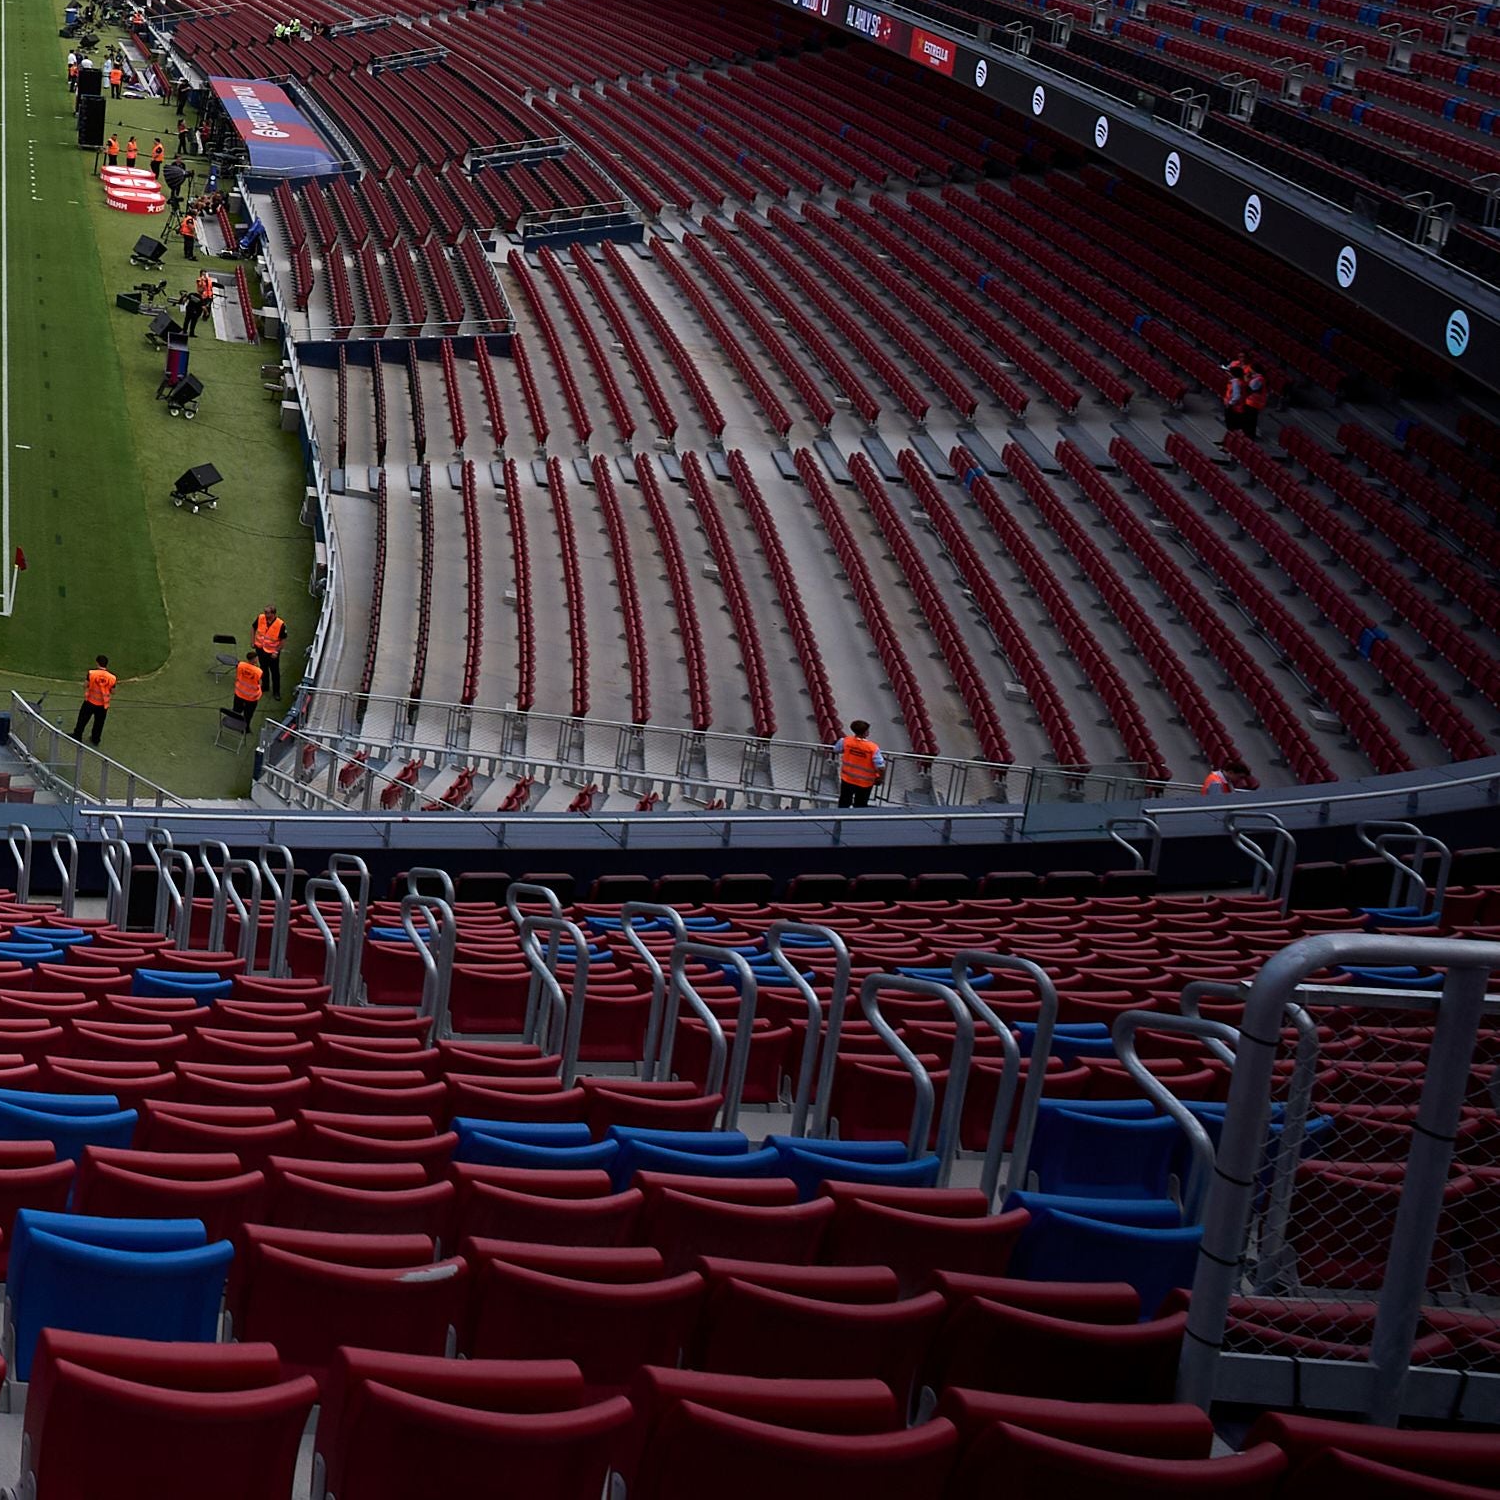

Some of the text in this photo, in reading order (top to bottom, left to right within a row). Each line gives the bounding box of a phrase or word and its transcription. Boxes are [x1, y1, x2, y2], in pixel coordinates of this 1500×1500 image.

[846, 4, 854, 27] AL
[854, 7, 872, 34] AHLY
[870, 14, 882, 38] SC
[231, 85, 256, 97] NOU
[237, 96, 265, 110] CAMP
